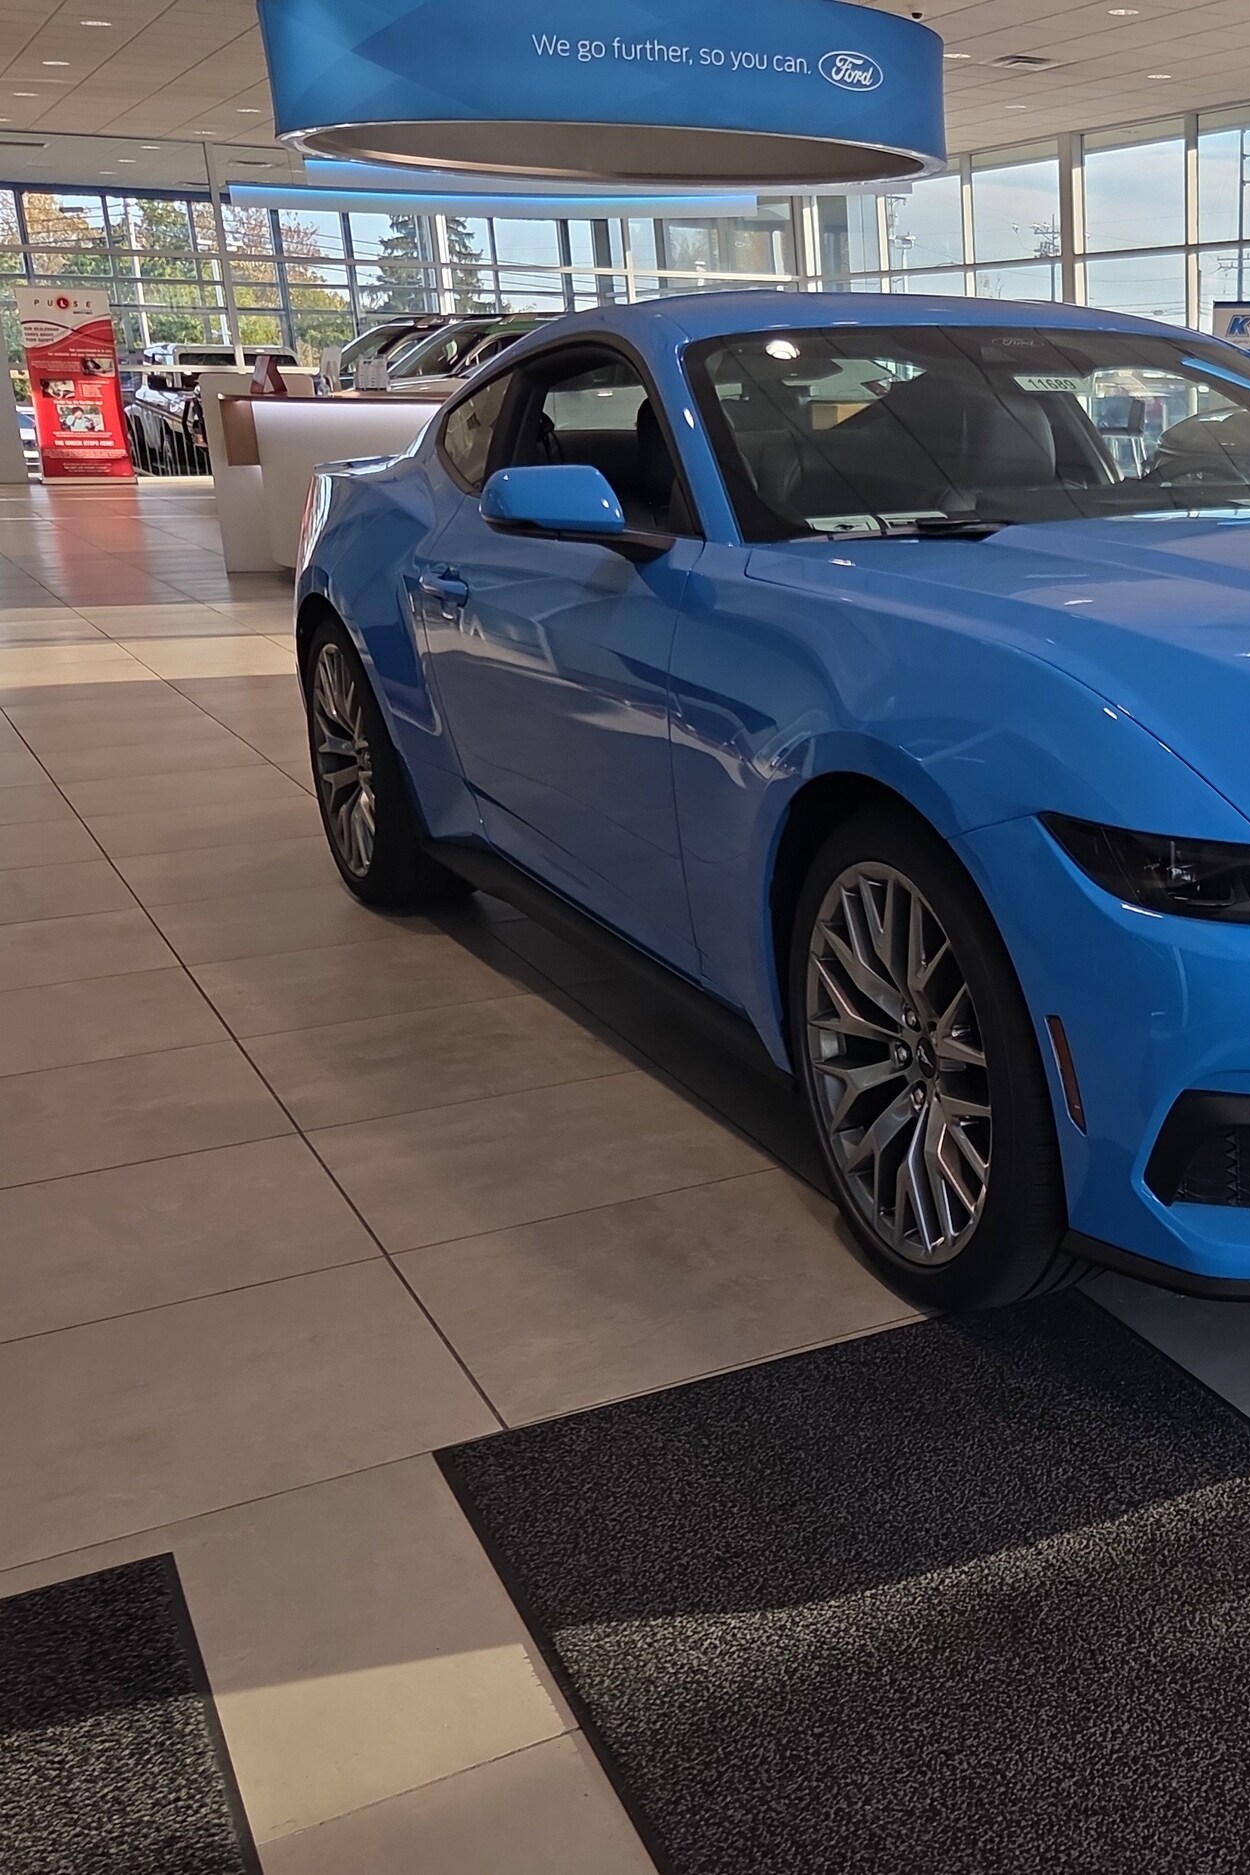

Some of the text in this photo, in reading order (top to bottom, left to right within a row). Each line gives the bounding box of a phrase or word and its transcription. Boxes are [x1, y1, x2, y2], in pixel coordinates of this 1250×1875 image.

[531, 33, 812, 75] We go further, so you can.
[831, 54, 875, 87] Ford
[33, 298, 92, 309] PULSE
[1027, 378, 1077, 390] 11689
